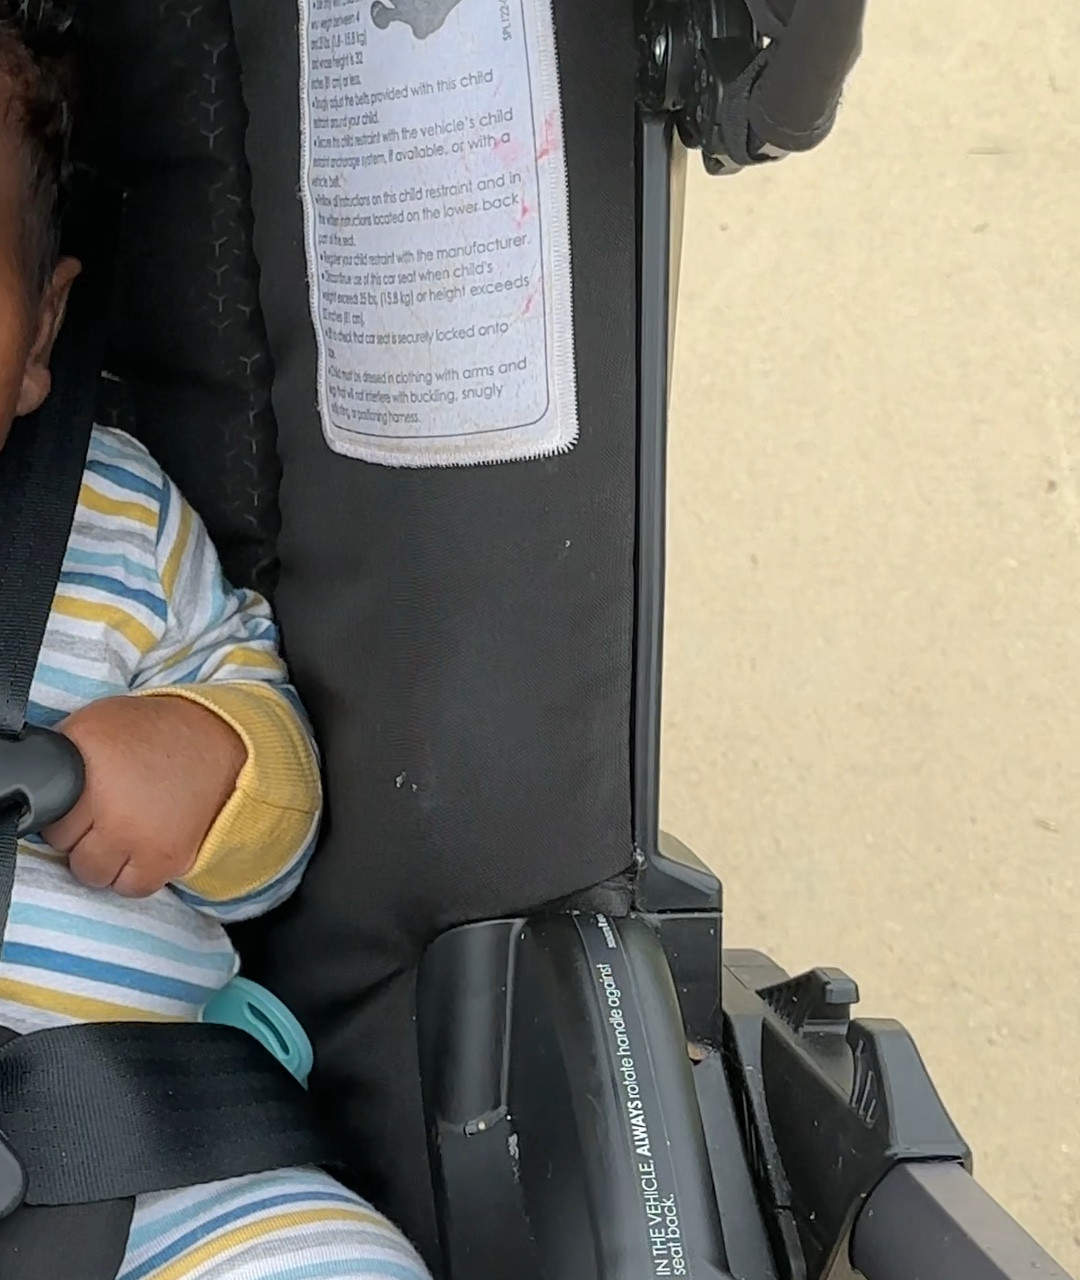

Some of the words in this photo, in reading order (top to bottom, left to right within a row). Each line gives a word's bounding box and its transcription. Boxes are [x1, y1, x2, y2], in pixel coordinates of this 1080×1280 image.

[370, 85, 409, 107] provided
[410, 82, 434, 98] with
[437, 76, 457, 93] this
[459, 69, 494, 89] child
[401, 125, 418, 139] the
[419, 115, 476, 138] vehicle's
[479, 107, 514, 127] child
[451, 140, 465, 153] or
[467, 133, 497, 151] with
[500, 131, 511, 143] a
[398, 187, 424, 205] child
[425, 180, 473, 200] restraint
[476, 173, 506, 192] and
[509, 171, 522, 185] in
[407, 210, 420, 221] on
[422, 207, 441, 220] the
[443, 202, 479, 219] lower
[482, 191, 520, 211] back
[416, 246, 434, 262] the
[436, 233, 531, 261] manufacturer.
[419, 265, 451, 282] when
[452, 261, 494, 280] child's
[428, 284, 466, 303] height
[469, 275, 530, 297] exceeds
[397, 330, 435, 347] securely
[435, 324, 475, 342] locked
[477, 320, 510, 336] onto
[434, 367, 460, 381] with
[462, 365, 495, 379] arms
[498, 356, 527, 374] and
[461, 383, 504, 400] snugly
[596, 963, 621, 1007] against
[609, 1009, 631, 1055] handle
[619, 1057, 640, 1098] rotate
[627, 1100, 652, 1157] ALWAYS
[661, 1193, 680, 1238] back.
[649, 1228, 668, 1256] THE
[654, 1259, 671, 1275] IN
[667, 1242, 686, 1275] seat
